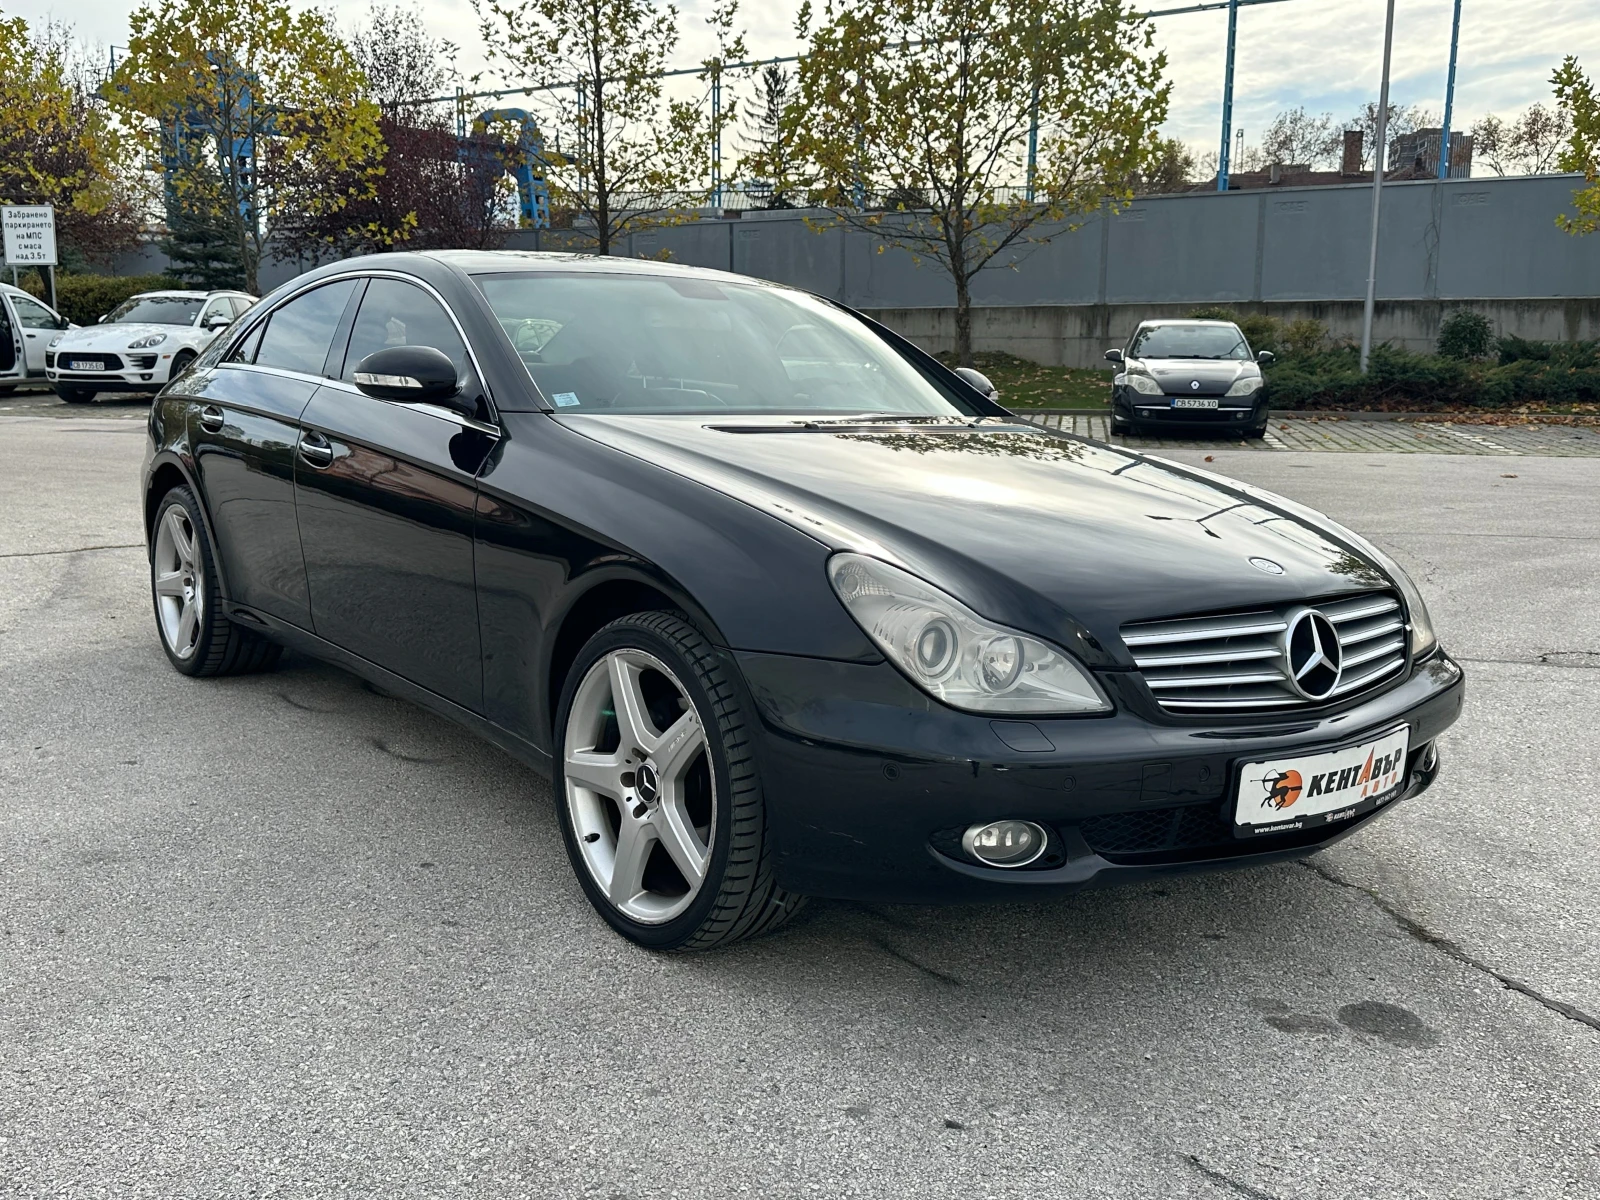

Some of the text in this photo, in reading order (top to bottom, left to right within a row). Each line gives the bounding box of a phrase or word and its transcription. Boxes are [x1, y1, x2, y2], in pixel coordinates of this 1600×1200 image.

[8, 210, 48, 219] Забранено
[5, 222, 52, 230] паркирането
[26, 232, 42, 240] МПС
[16, 253, 29, 261] над
[1306, 745, 1402, 798] КЕНТАВЪР
[1360, 771, 1398, 798] АВТО
[1254, 821, 1303, 834] www.kentavar.bg
